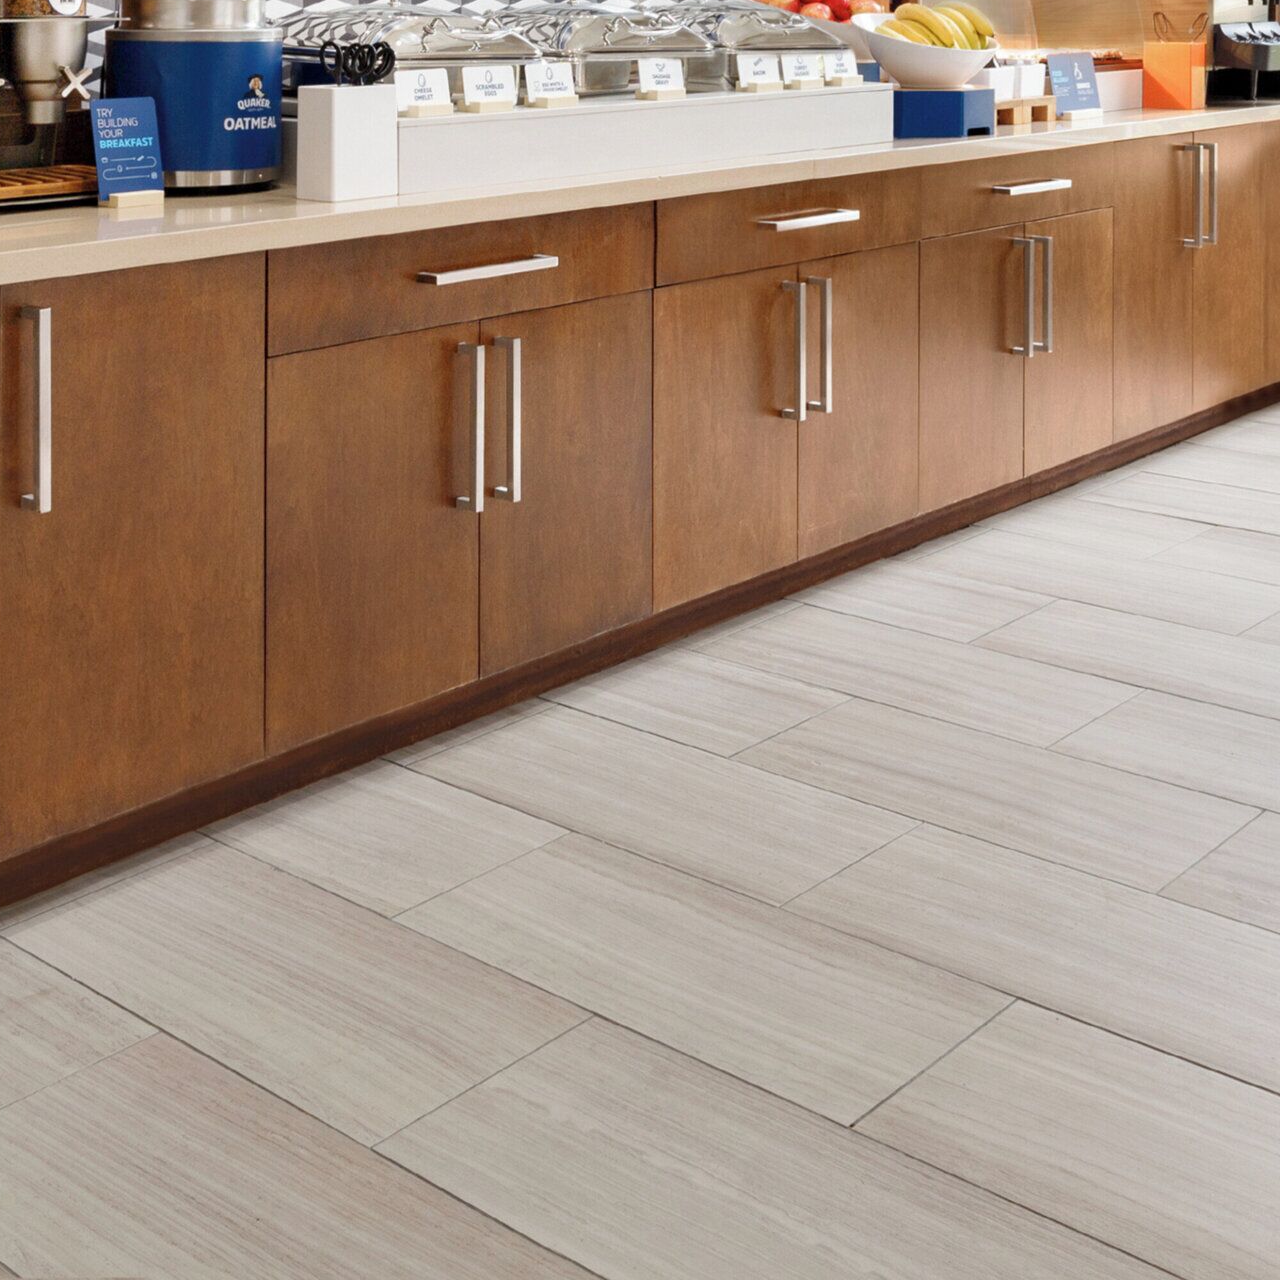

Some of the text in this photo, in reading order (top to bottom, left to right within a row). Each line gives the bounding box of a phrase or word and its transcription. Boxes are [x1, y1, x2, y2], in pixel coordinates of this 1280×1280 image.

[237, 97, 271, 111] QUAKER
[96, 108, 113, 118] TRY
[97, 117, 139, 128] BUILDING
[223, 116, 277, 132] OATMEAL
[99, 128, 124, 138] YOUR
[99, 137, 154, 150] BREAKFAST
